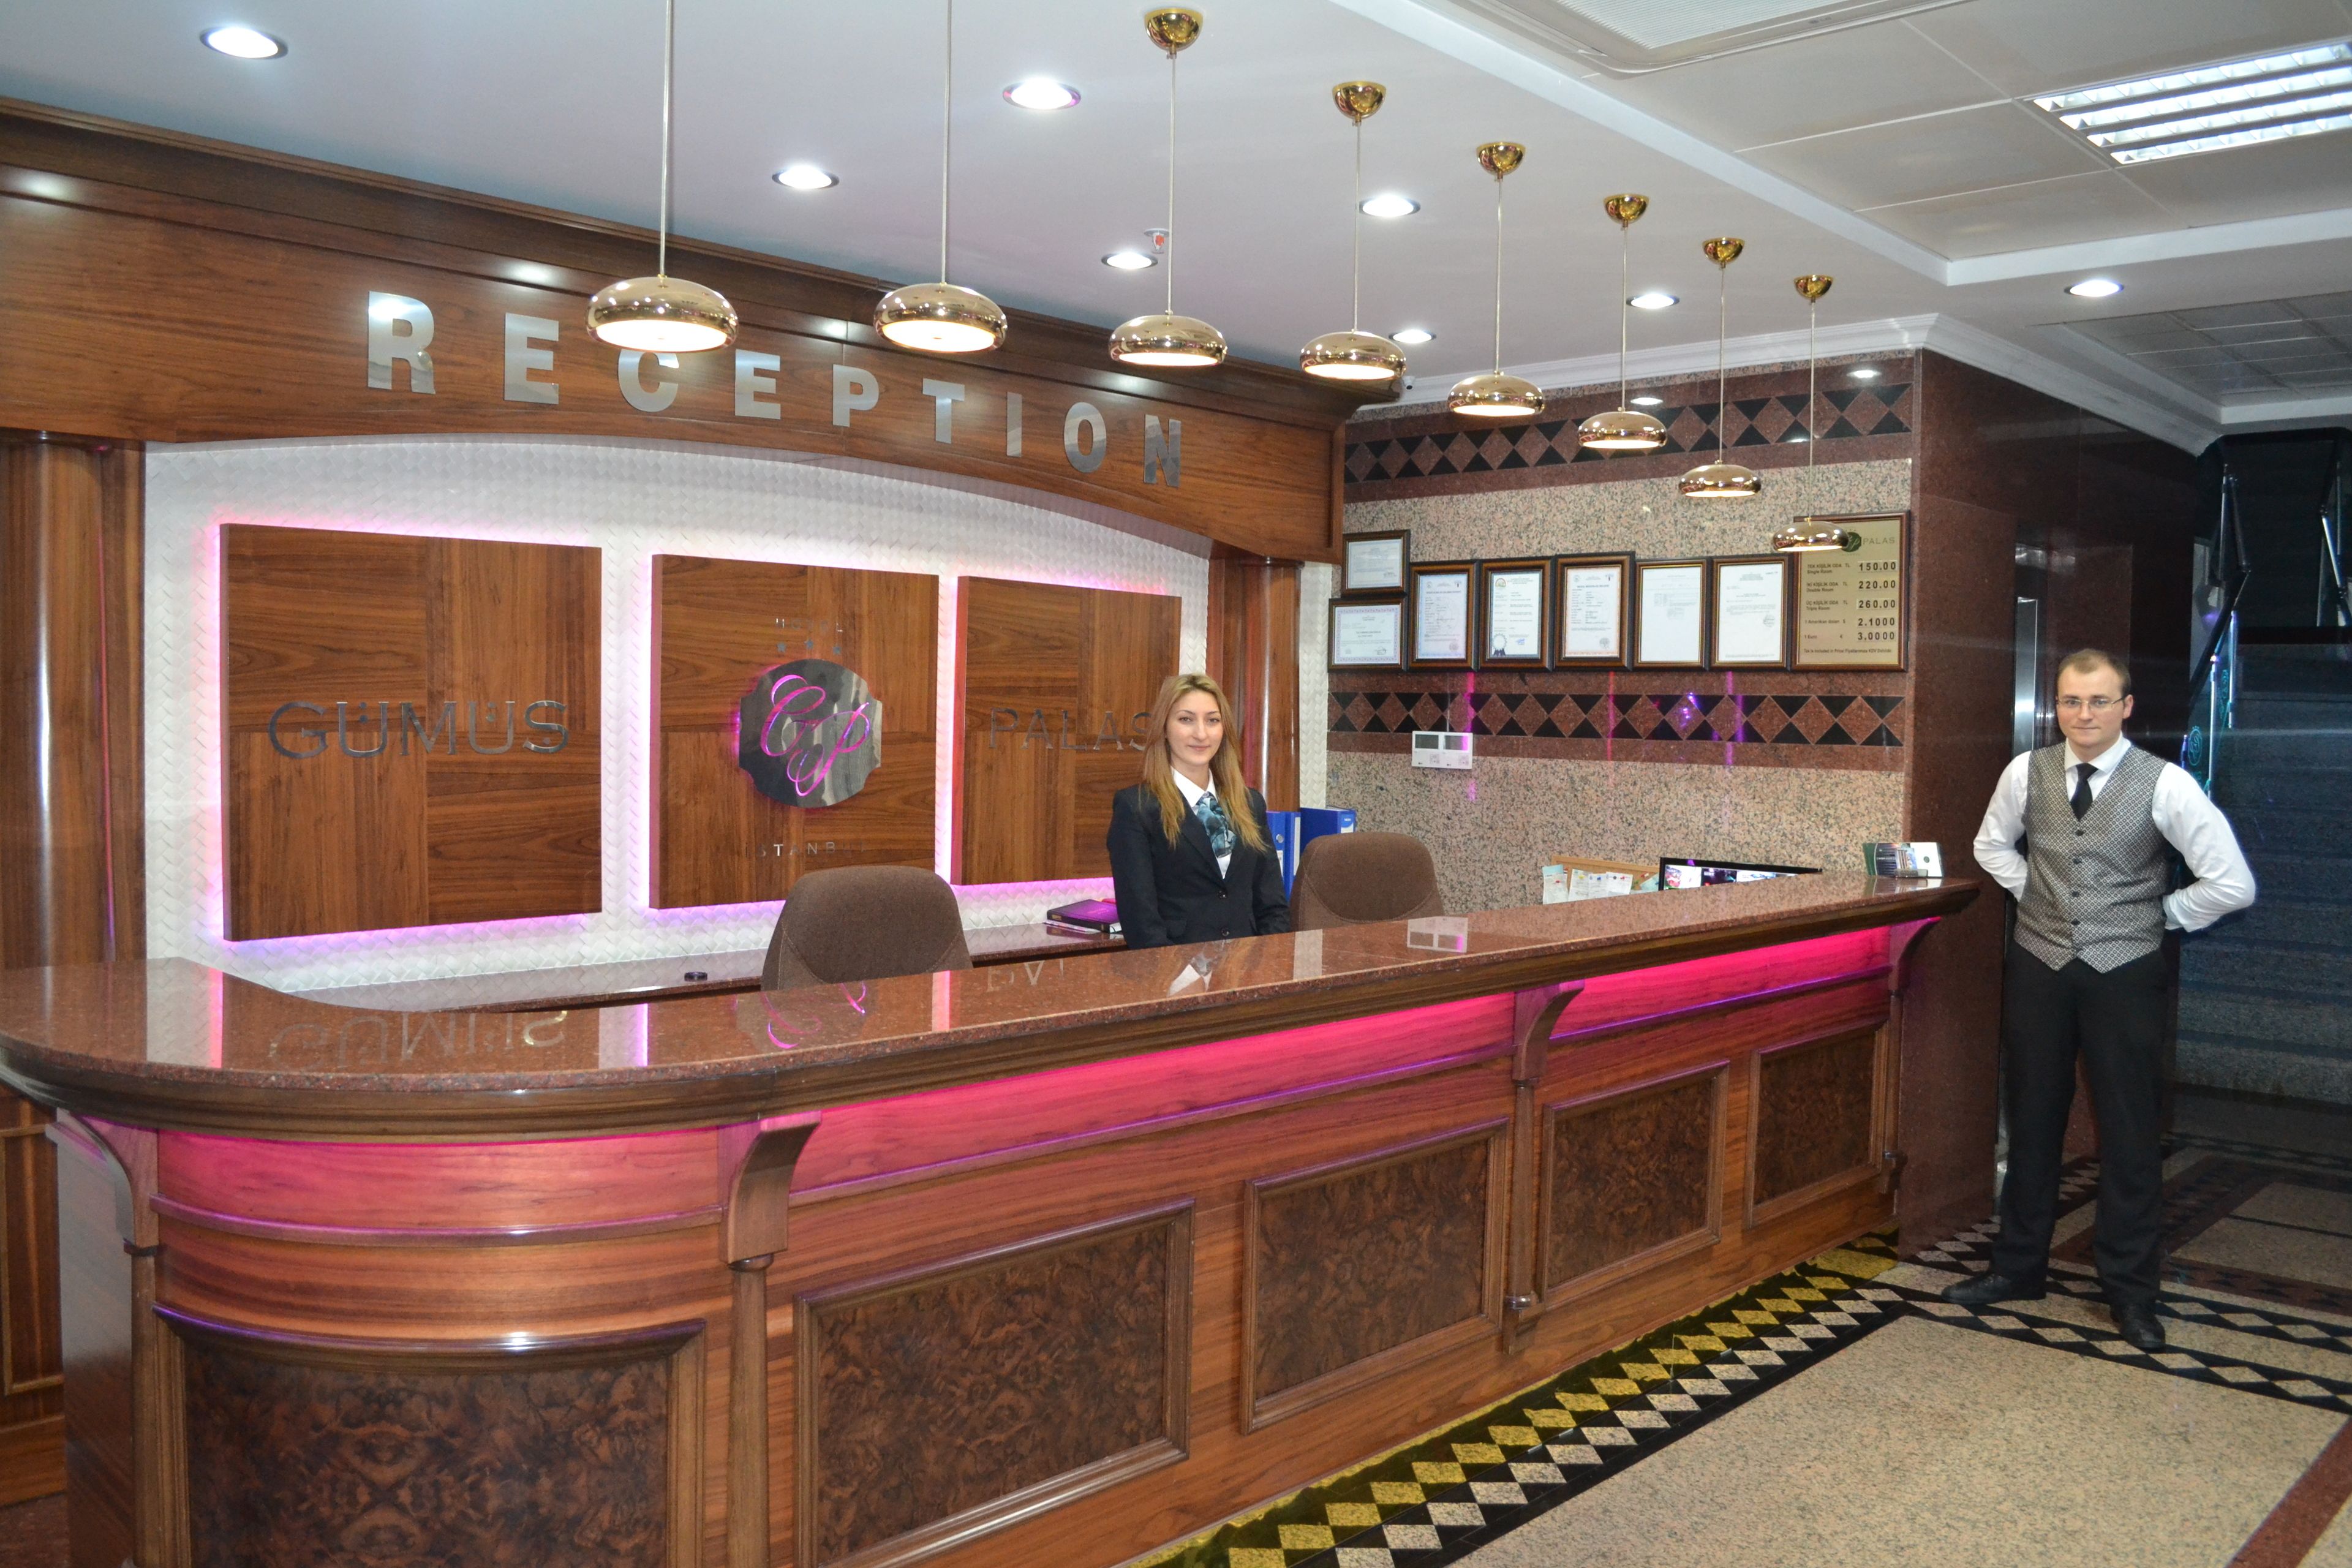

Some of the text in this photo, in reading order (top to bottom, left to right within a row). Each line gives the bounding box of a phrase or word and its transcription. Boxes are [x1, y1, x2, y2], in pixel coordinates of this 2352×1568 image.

[368, 291, 1182, 488] RECEPTION
[1859, 562, 1896, 571] 150.00
[1858, 580, 1896, 589] 220.00
[1858, 600, 1896, 608] 260.00
[1858, 617, 1895, 626] 2.1000
[989, 708, 1152, 751] PALAS
